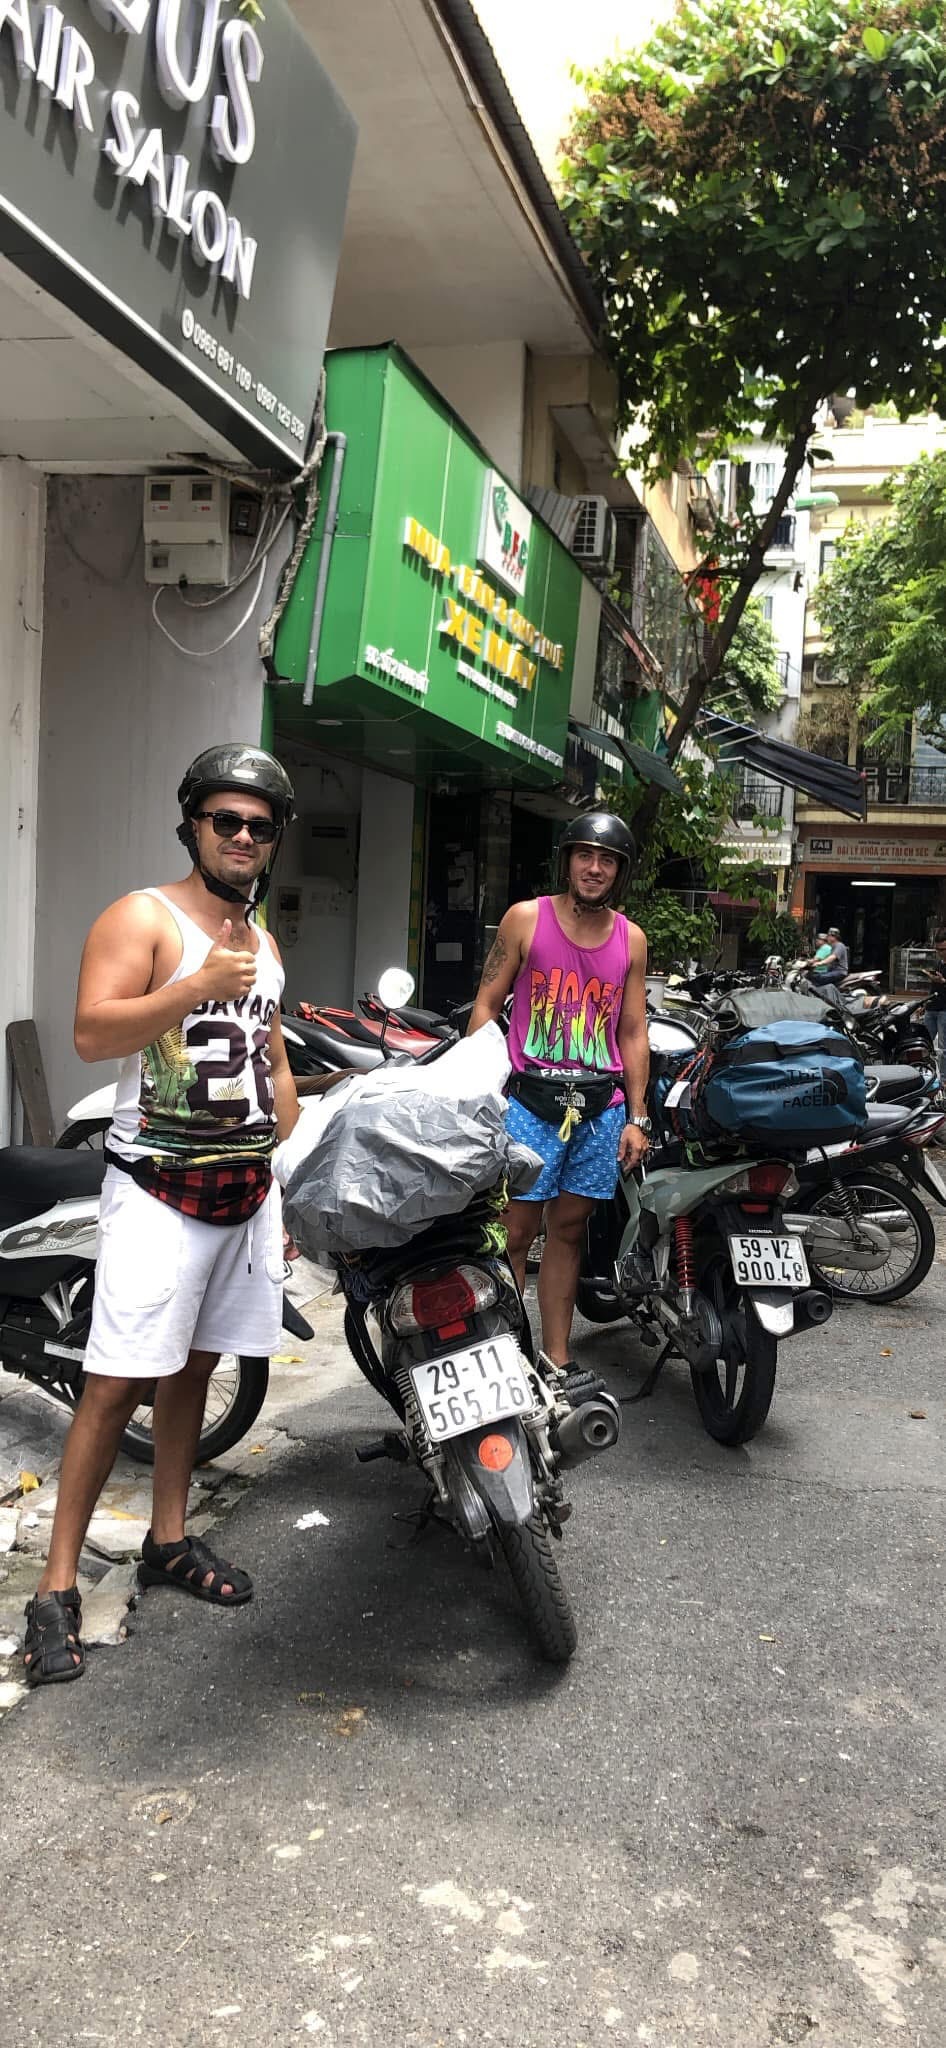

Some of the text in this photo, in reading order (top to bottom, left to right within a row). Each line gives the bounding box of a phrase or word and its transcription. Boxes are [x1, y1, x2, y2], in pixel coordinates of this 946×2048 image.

[108, 0, 264, 164] US
[104, 90, 257, 299] SALON
[236, 362, 252, 391] 109
[437, 595, 485, 655] XE
[541, 1068, 582, 1078] FACE
[783, 1095, 823, 1108] FACE
[740, 1239, 793, 1259] 59-V2
[738, 1261, 803, 1282] 900.48
[427, 1345, 504, 1396] 29-T1
[428, 1376, 525, 1432] 565.26
